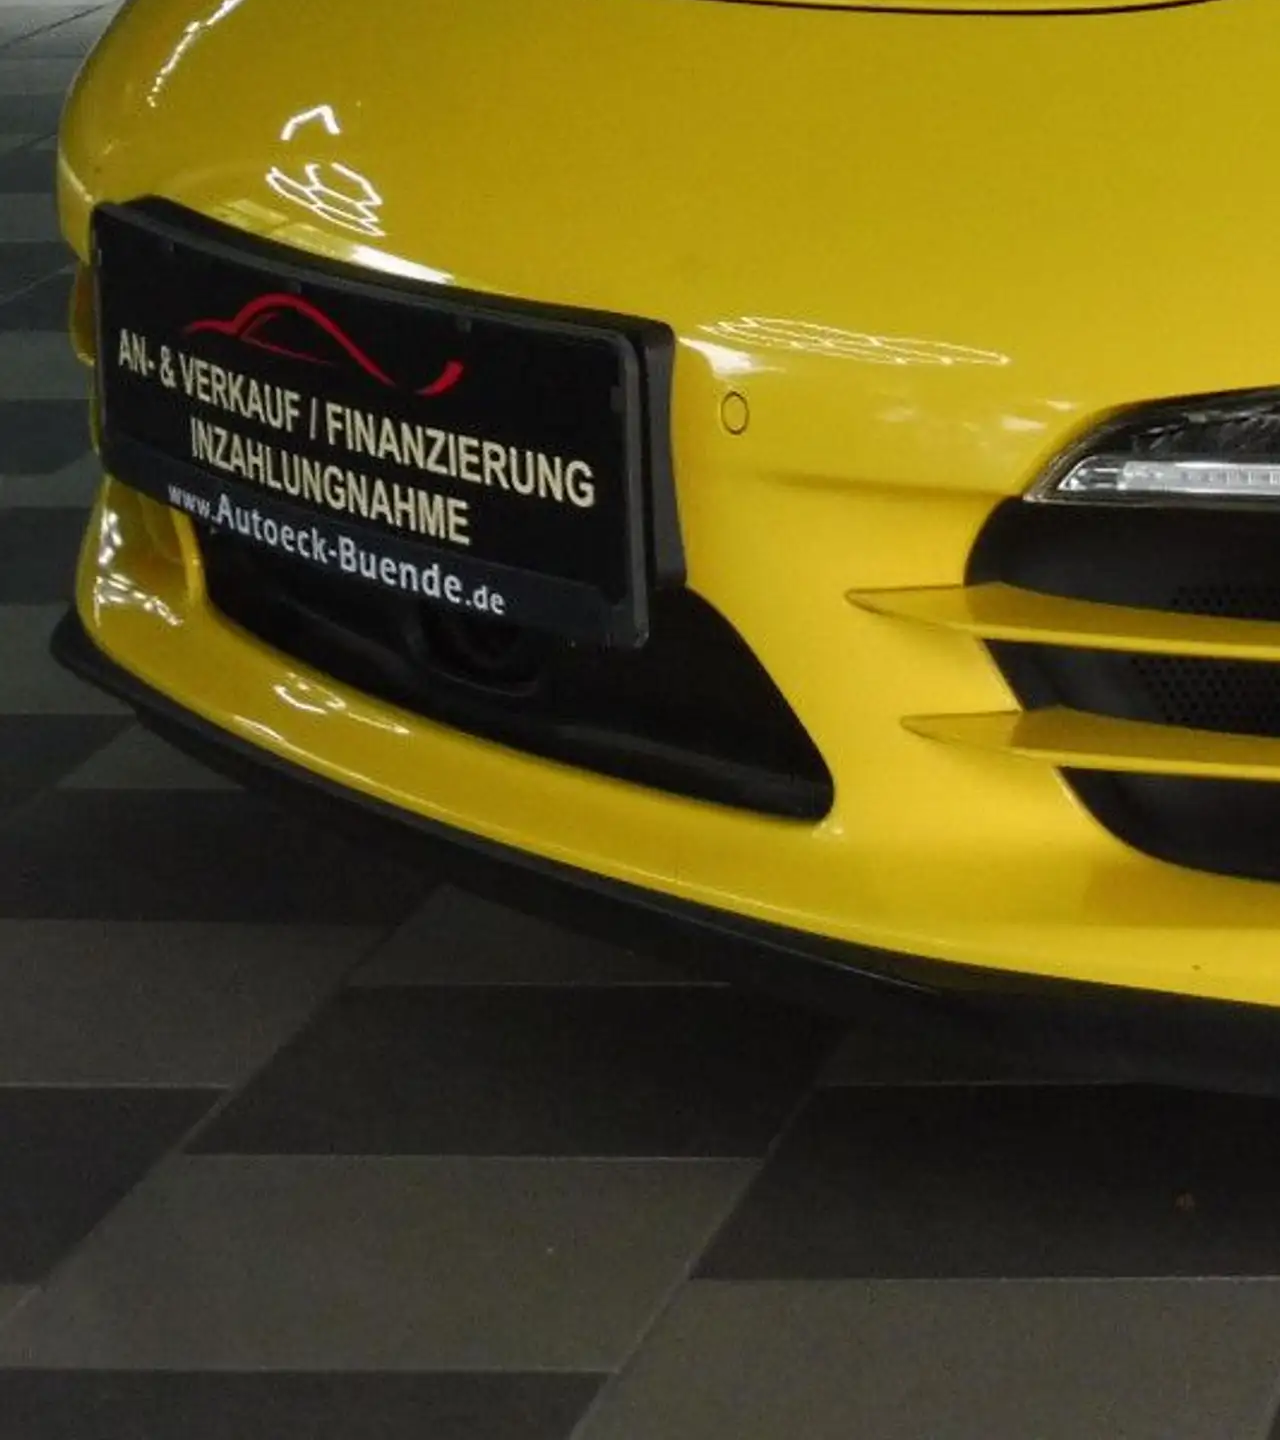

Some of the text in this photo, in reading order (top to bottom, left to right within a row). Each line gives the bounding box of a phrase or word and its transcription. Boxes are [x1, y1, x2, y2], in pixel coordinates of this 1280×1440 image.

[118, 327, 596, 509] AN- & VERKAUF / FINANZIERUNG
[190, 416, 472, 546] INZAHLUNGNAHME
[167, 484, 506, 616] www.Autoeck-Buende.de
